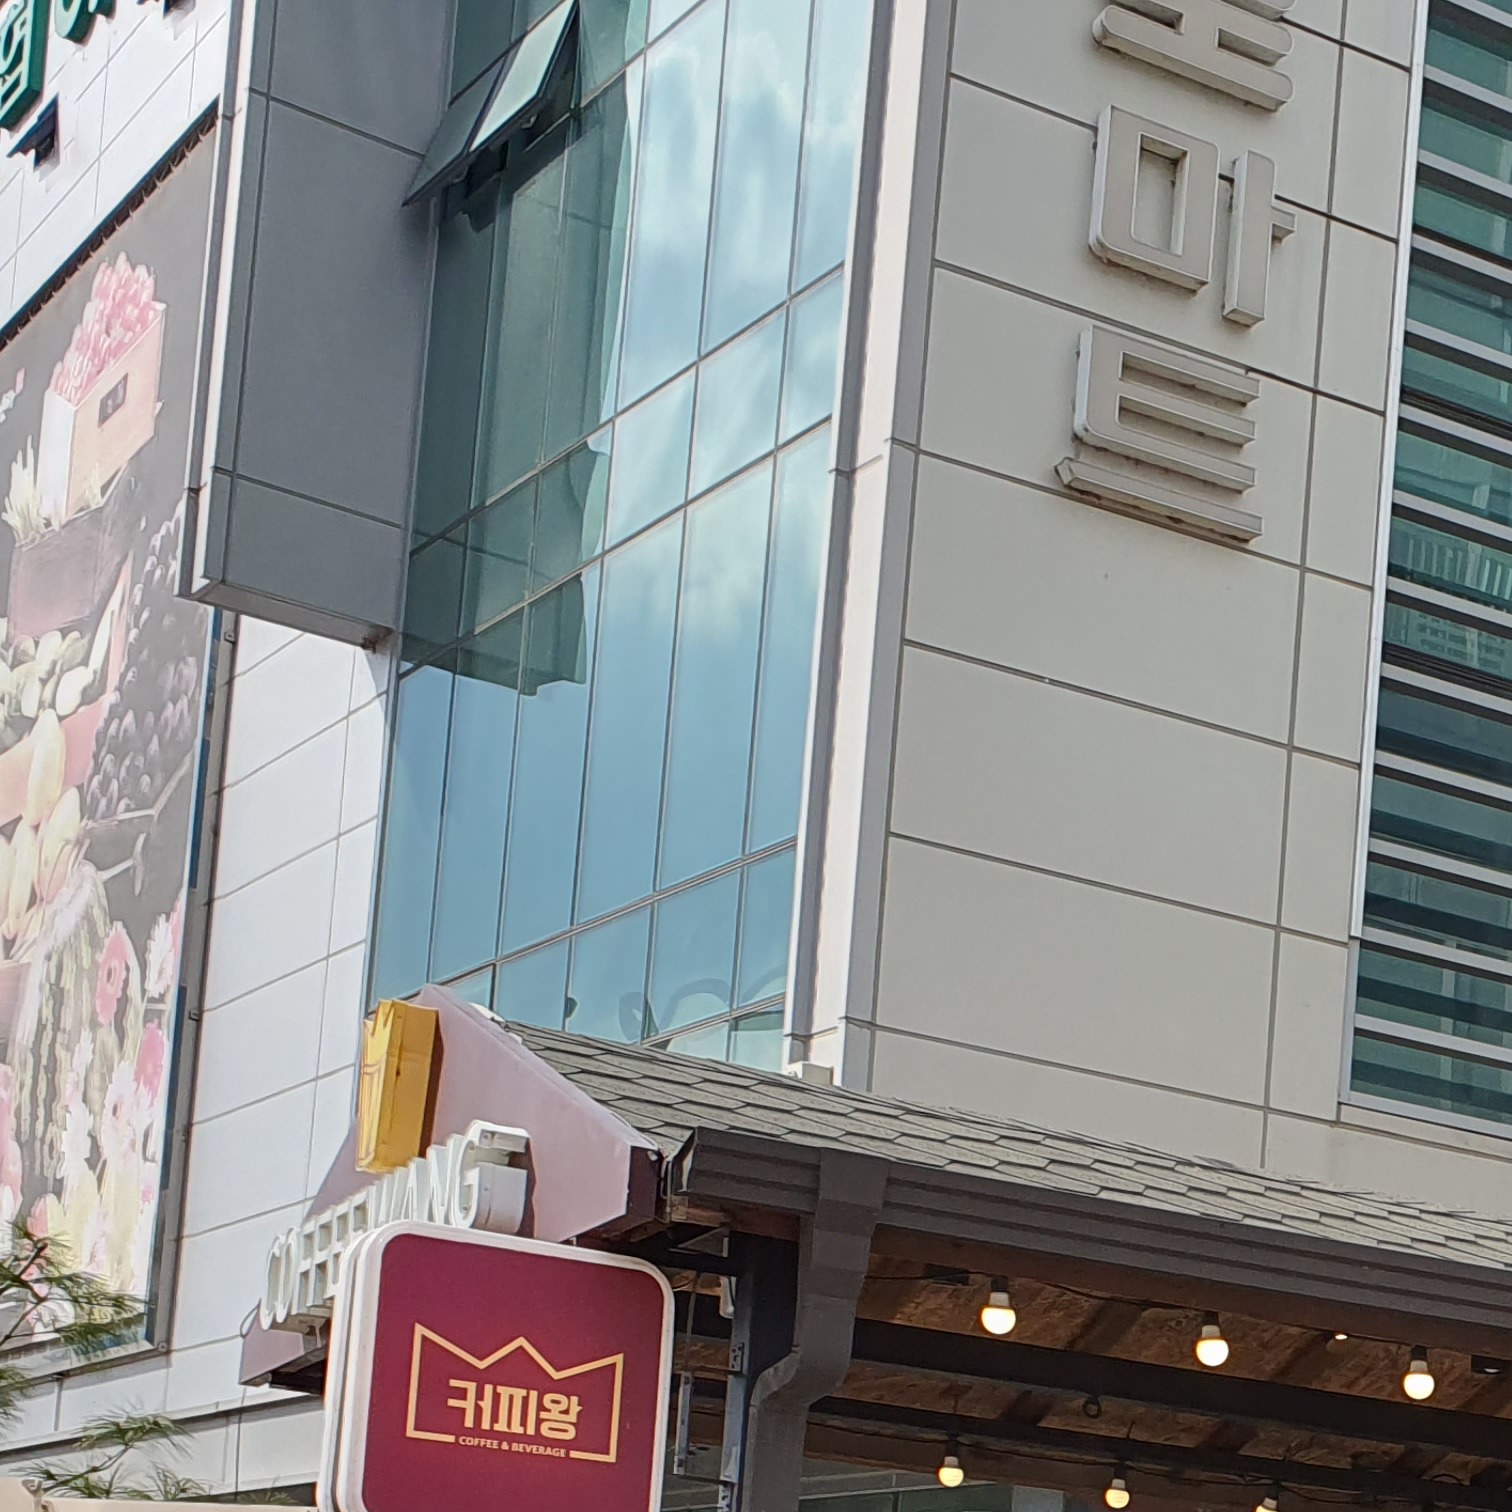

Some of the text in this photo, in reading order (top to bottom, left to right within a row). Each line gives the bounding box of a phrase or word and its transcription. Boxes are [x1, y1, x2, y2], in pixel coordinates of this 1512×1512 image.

[447, 1378, 583, 1441] 커피왕
[458, 1435, 567, 1458] COFFEE & BEVERAGE
